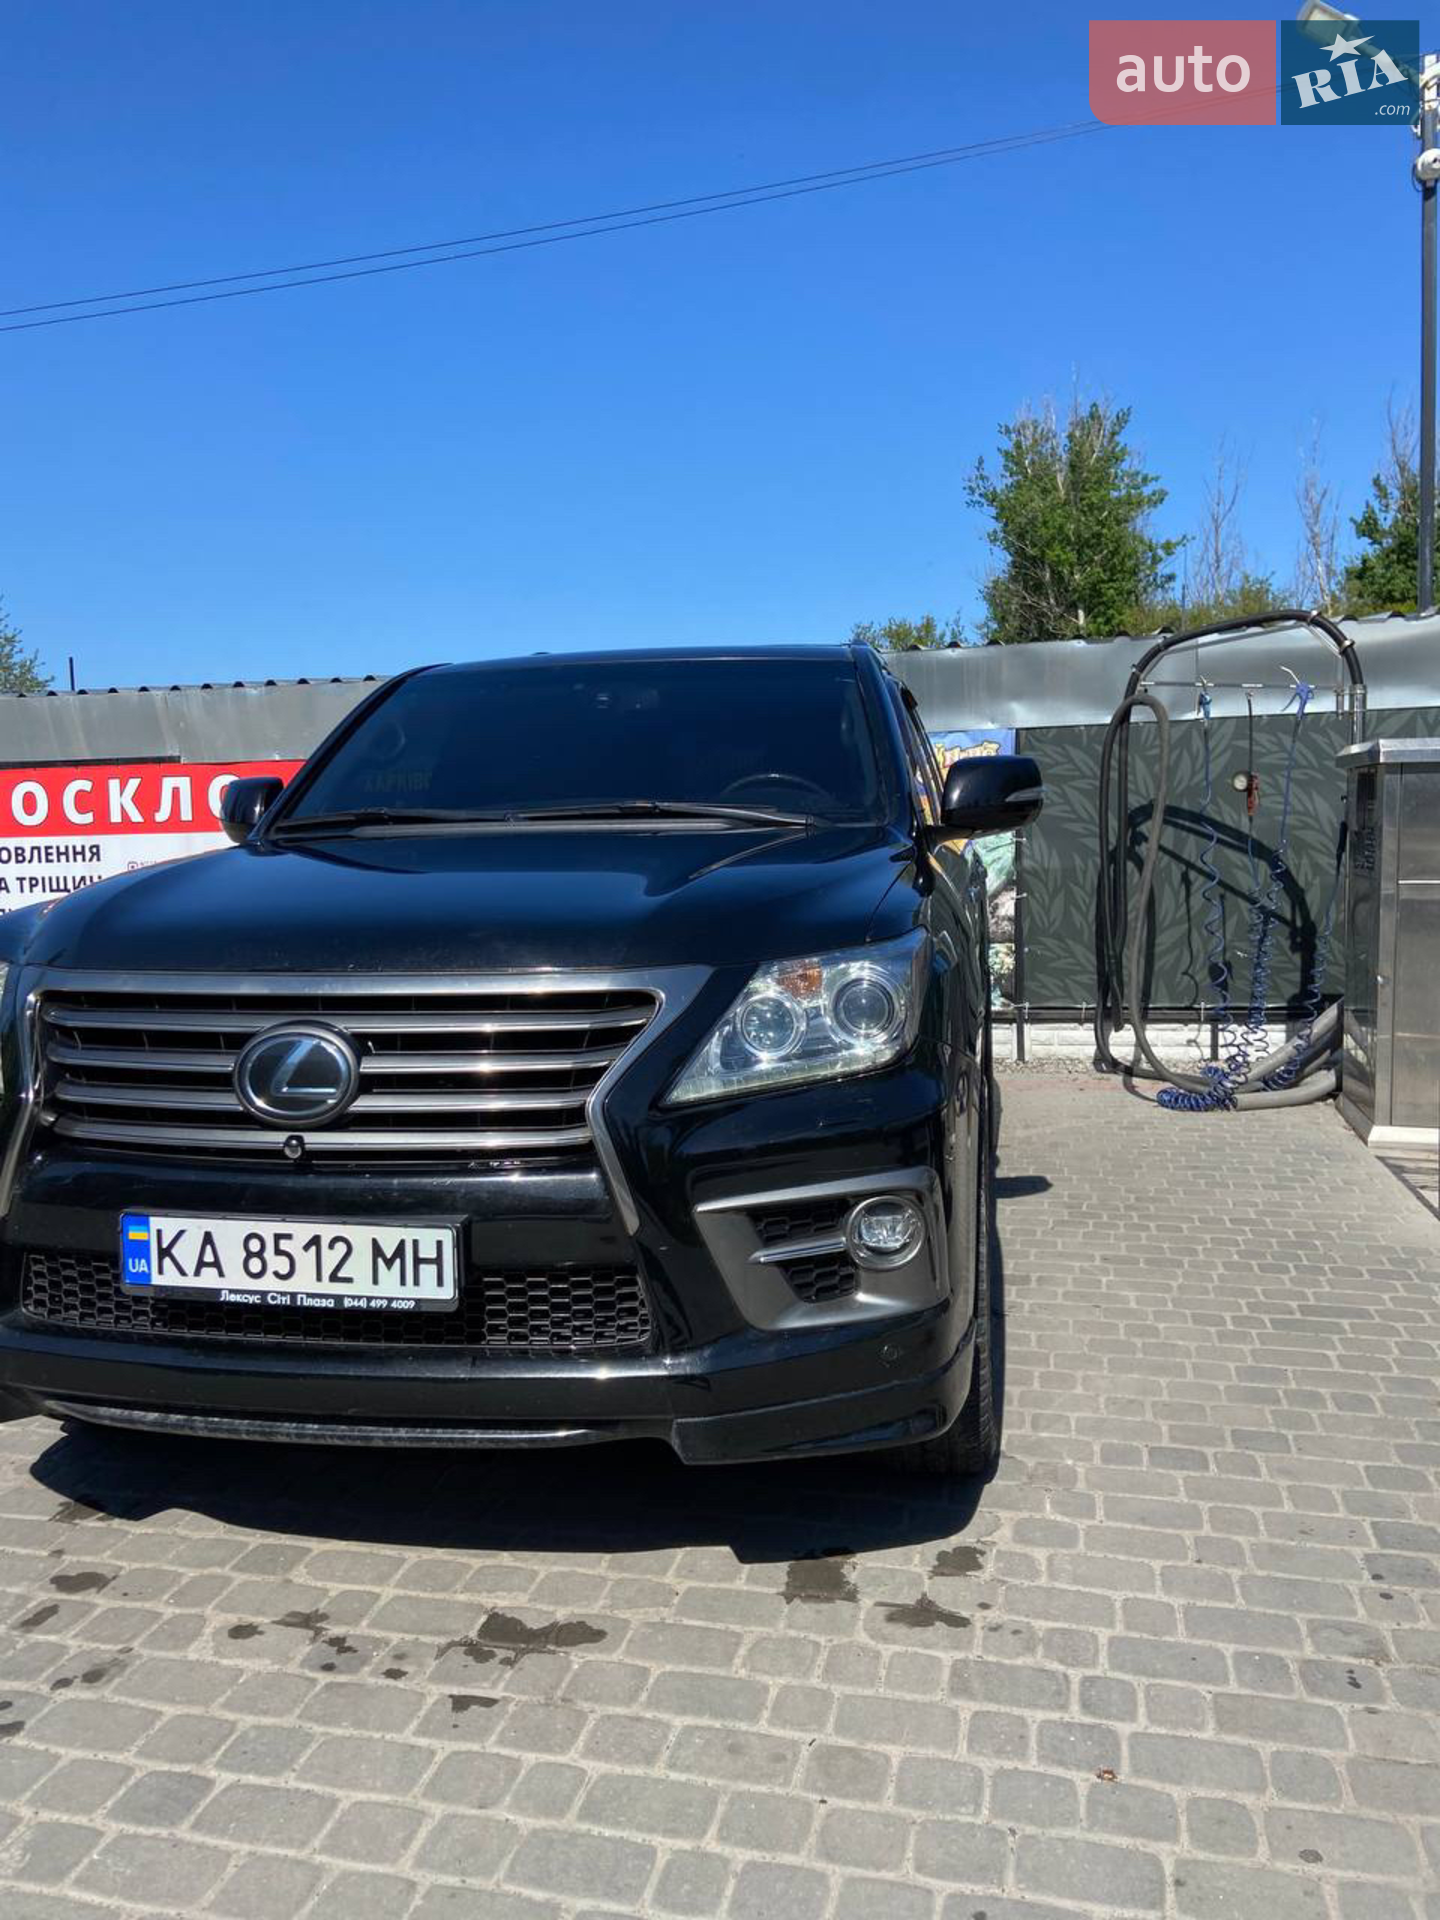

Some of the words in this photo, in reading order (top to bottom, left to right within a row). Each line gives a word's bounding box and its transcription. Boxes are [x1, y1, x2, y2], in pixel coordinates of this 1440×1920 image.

[128, 1258, 149, 1274] UA
[156, 1228, 226, 1279] KA
[242, 1232, 355, 1284] 8512
[371, 1237, 445, 1288] MH
[220, 1290, 261, 1305] Лексус
[297, 1294, 335, 1309] Плаза
[343, 1296, 367, 1310] (044)
[369, 1297, 388, 1309] 499
[390, 1299, 416, 1310] 4009
